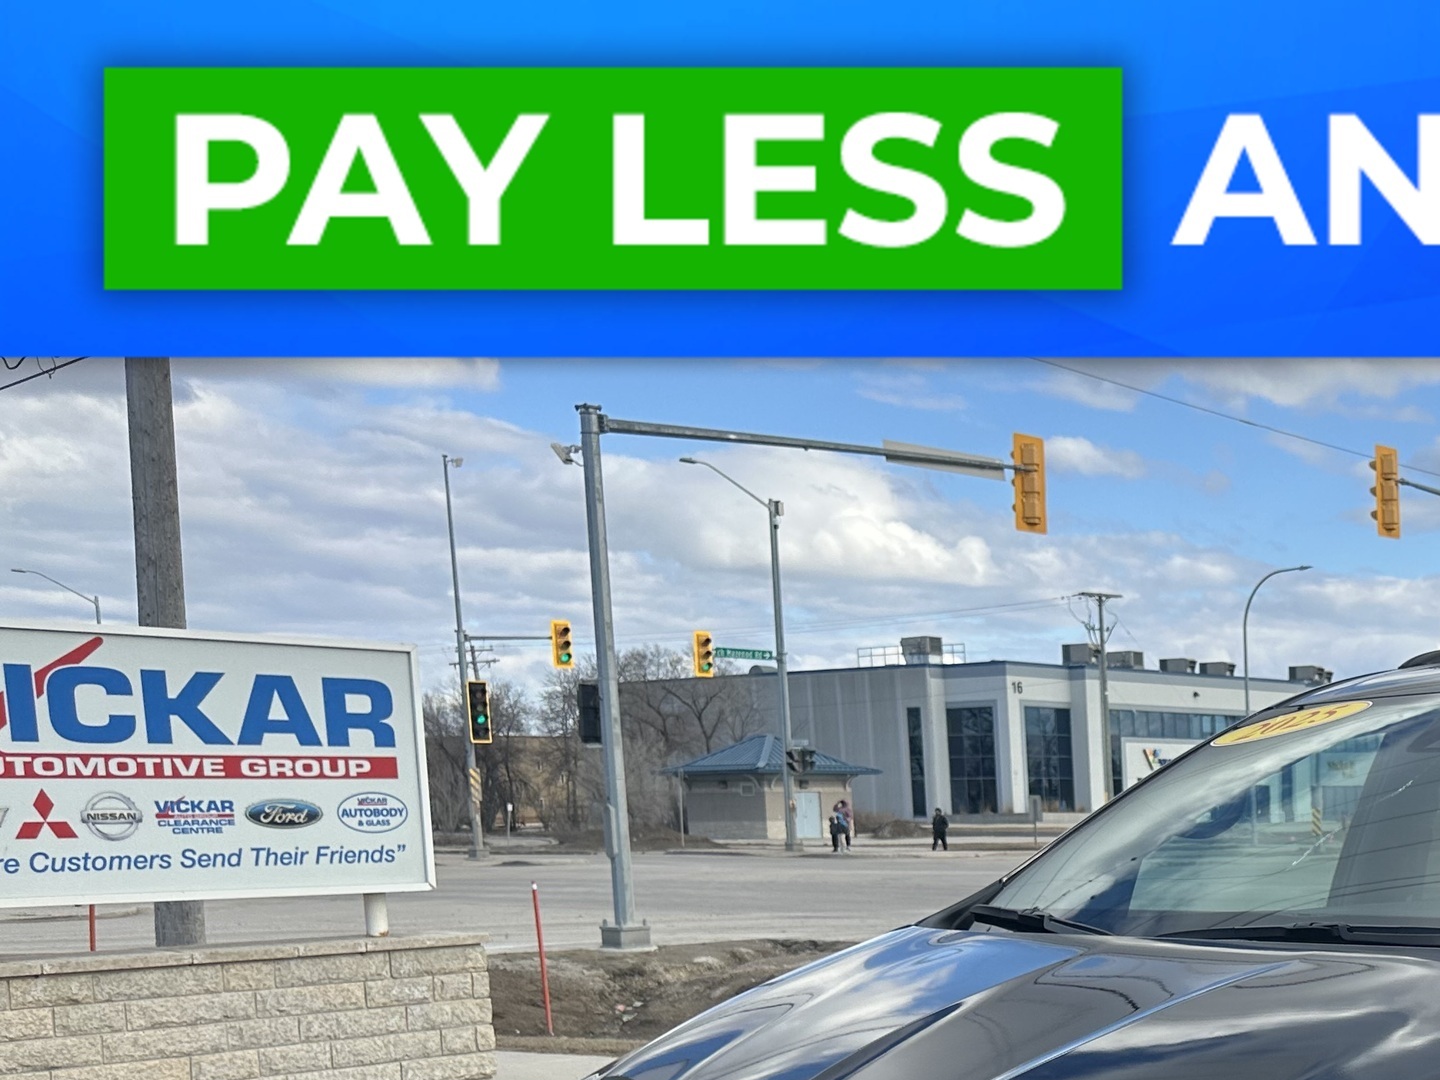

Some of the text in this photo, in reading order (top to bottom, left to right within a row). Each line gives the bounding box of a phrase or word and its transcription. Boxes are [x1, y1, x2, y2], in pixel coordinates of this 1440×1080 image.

[1011, 681, 1023, 694] 16
[0, 663, 396, 748] ICKAR
[1231, 704, 1349, 743] 2025
[240, 757, 371, 777] GROUP
[154, 799, 234, 813] VICKAR
[341, 808, 404, 818] AUTOBODY
[260, 803, 308, 824] Ford
[158, 819, 235, 827] CLEARANCE
[365, 819, 391, 827] GLASS
[172, 826, 223, 835] CENTRE
[29, 850, 172, 873] Customers
[180, 848, 242, 869] Send
[250, 846, 309, 867] Their
